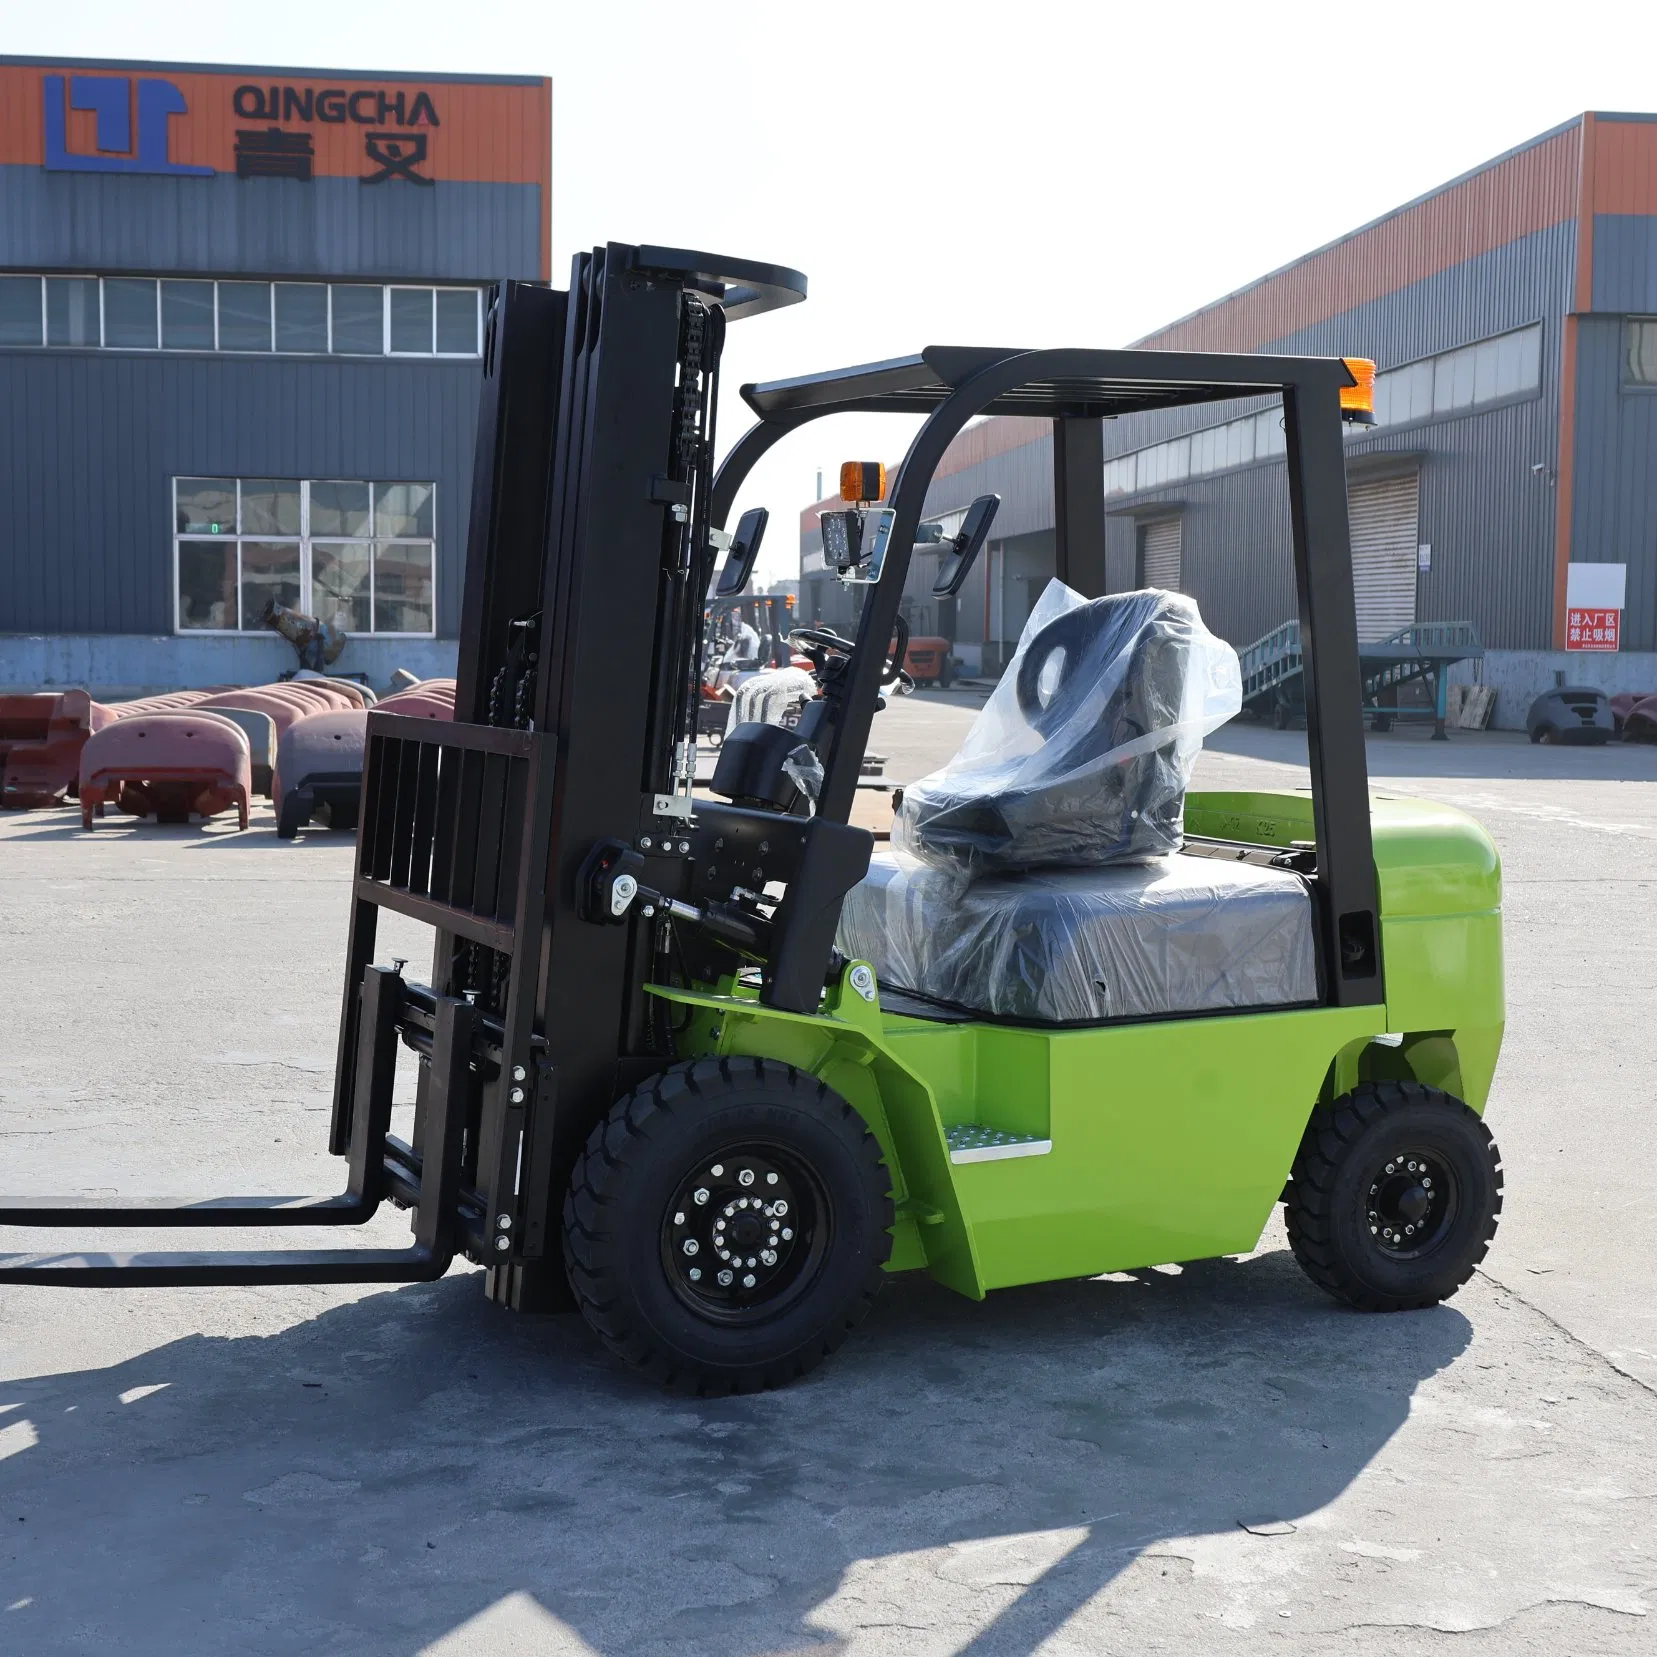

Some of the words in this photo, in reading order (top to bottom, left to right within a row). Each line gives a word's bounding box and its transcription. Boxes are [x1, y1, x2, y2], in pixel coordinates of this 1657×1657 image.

[233, 85, 440, 127] QINGCHA
[1570, 612, 1616, 627] 进入厂区
[1570, 628, 1616, 642] 禁止吸烟
